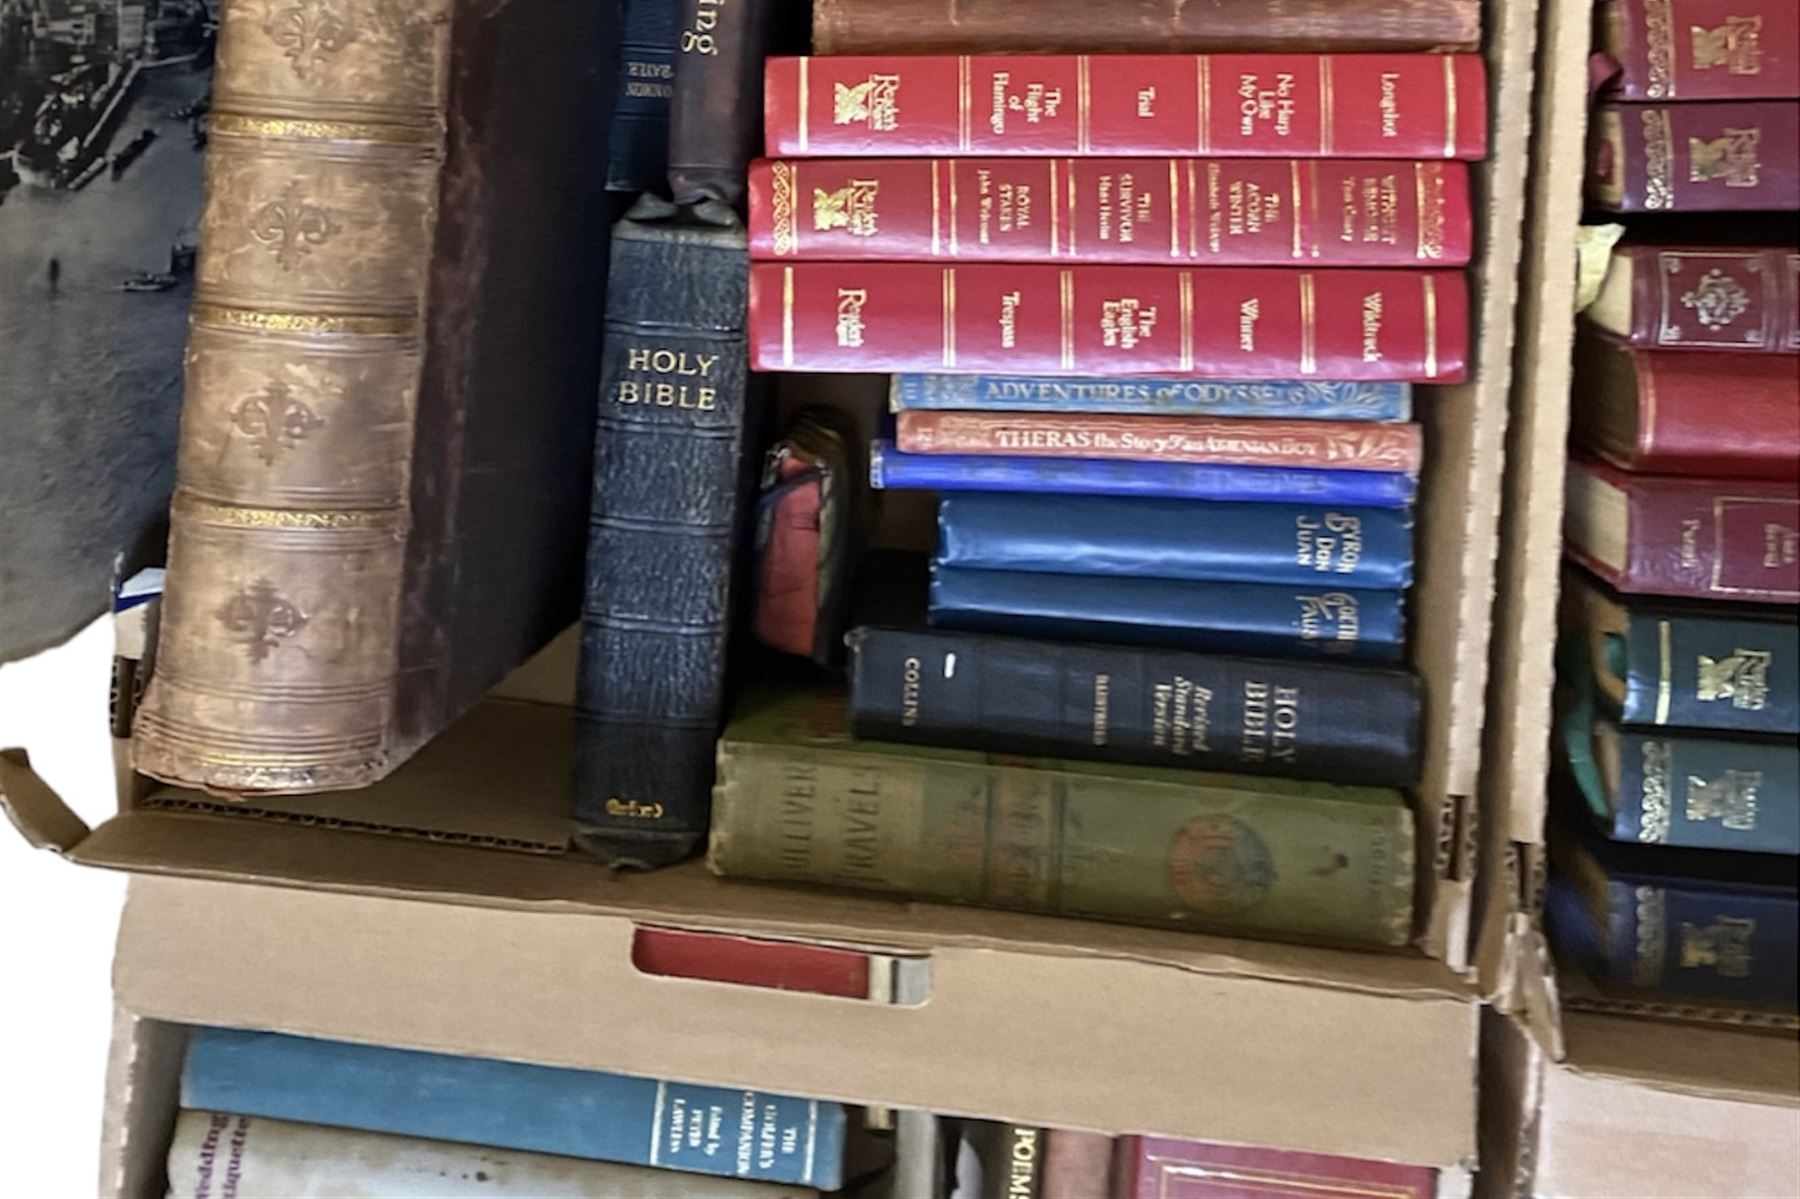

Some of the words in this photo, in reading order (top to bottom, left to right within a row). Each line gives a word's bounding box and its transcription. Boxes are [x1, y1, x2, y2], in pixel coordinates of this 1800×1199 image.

[990, 73, 1009, 134] Flamingo
[1009, 96, 1024, 110] of
[1024, 84, 1043, 123] Flight
[1045, 88, 1061, 117] The
[1138, 87, 1156, 117] Trial
[1238, 75, 1257, 98] My
[1277, 74, 1294, 97] No
[1241, 100, 1258, 135] Own
[1259, 91, 1275, 119] Like
[1275, 101, 1295, 136] Harp
[1380, 74, 1400, 137] Longshot
[1017, 186, 1030, 229] ROYAL
[1119, 174, 1133, 242] SURVIVOR
[999, 292, 1020, 348] Trespass
[1102, 301, 1119, 346] Eagles
[1118, 299, 1138, 348] English
[1139, 307, 1156, 337] The
[1240, 299, 1259, 351] Winner
[628, 348, 719, 377] HOLY
[619, 380, 717, 410] BIBLE
[985, 382, 1150, 400] ADVENTURES
[995, 430, 1091, 448] THERAS
[1296, 516, 1320, 566] JUAN
[1316, 537, 1336, 572] DON
[1324, 512, 1362, 573] BYRON
[902, 658, 920, 726] COLLINS
[1242, 681, 1269, 761] BIBLE
[1272, 688, 1298, 761] HOLY
[737, 1093, 755, 1174] COMPANION
[781, 1128, 797, 1154] THE
